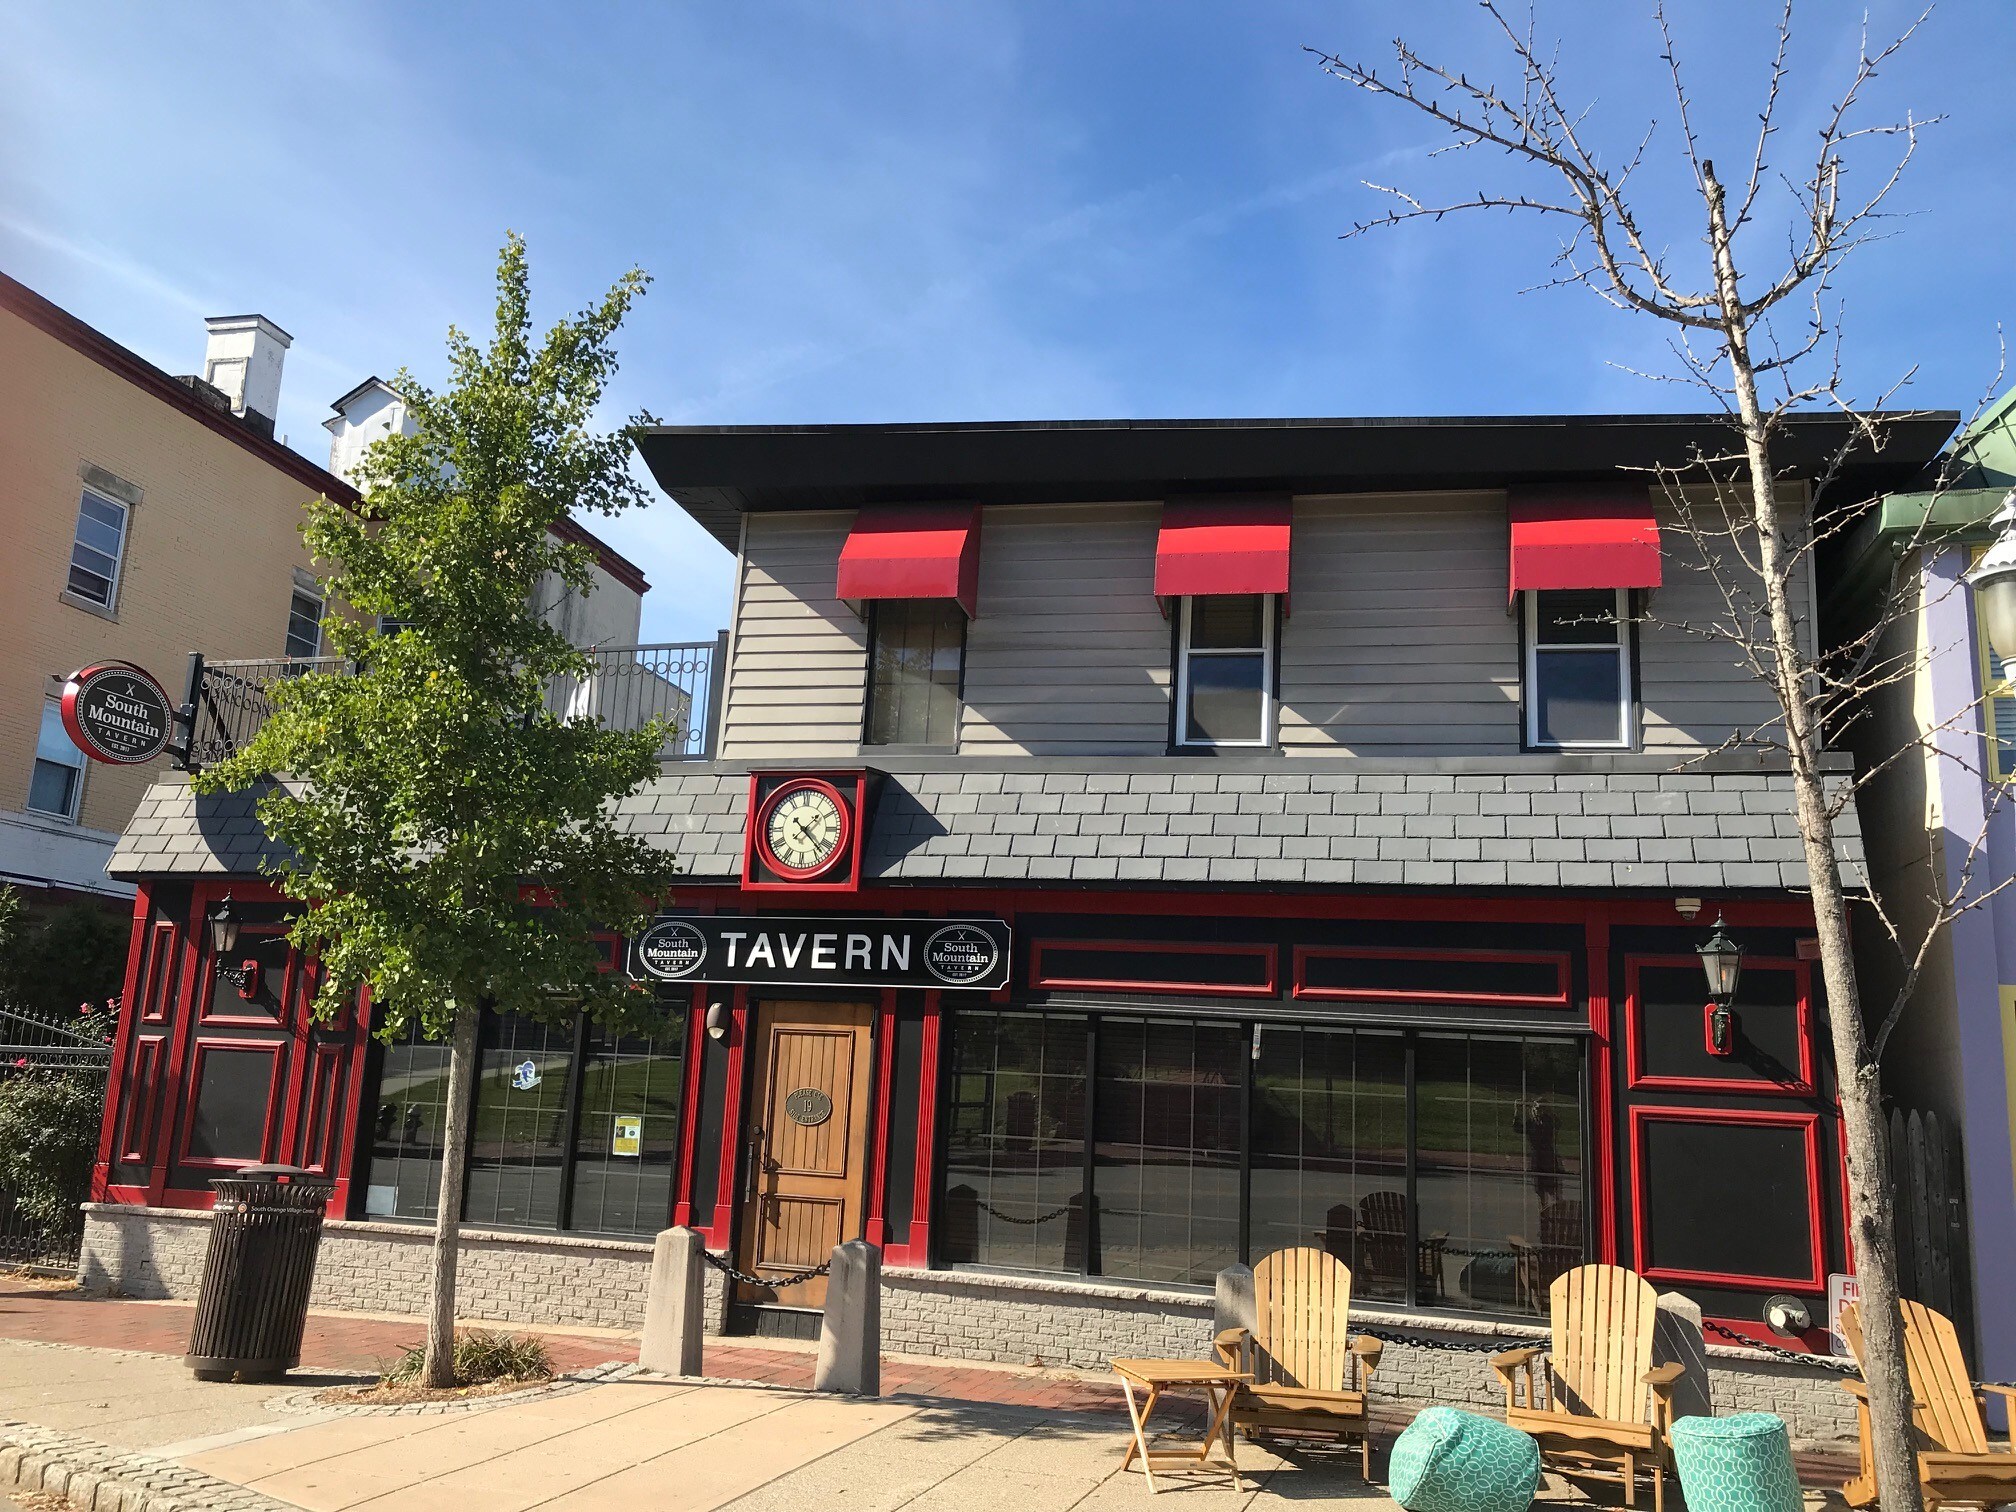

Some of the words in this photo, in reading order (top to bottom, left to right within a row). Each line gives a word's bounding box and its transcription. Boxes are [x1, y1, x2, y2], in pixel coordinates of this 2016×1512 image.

[105, 694, 148, 719] South
[88, 704, 159, 738] Mountain
[98, 728, 146, 747] TAVERN
[658, 938, 689, 948] South
[944, 942, 978, 953] South
[647, 948, 699, 958] Mountain
[720, 932, 911, 971] TAVERN
[932, 952, 989, 963] Mountain
[803, 1099, 813, 1112] 19
